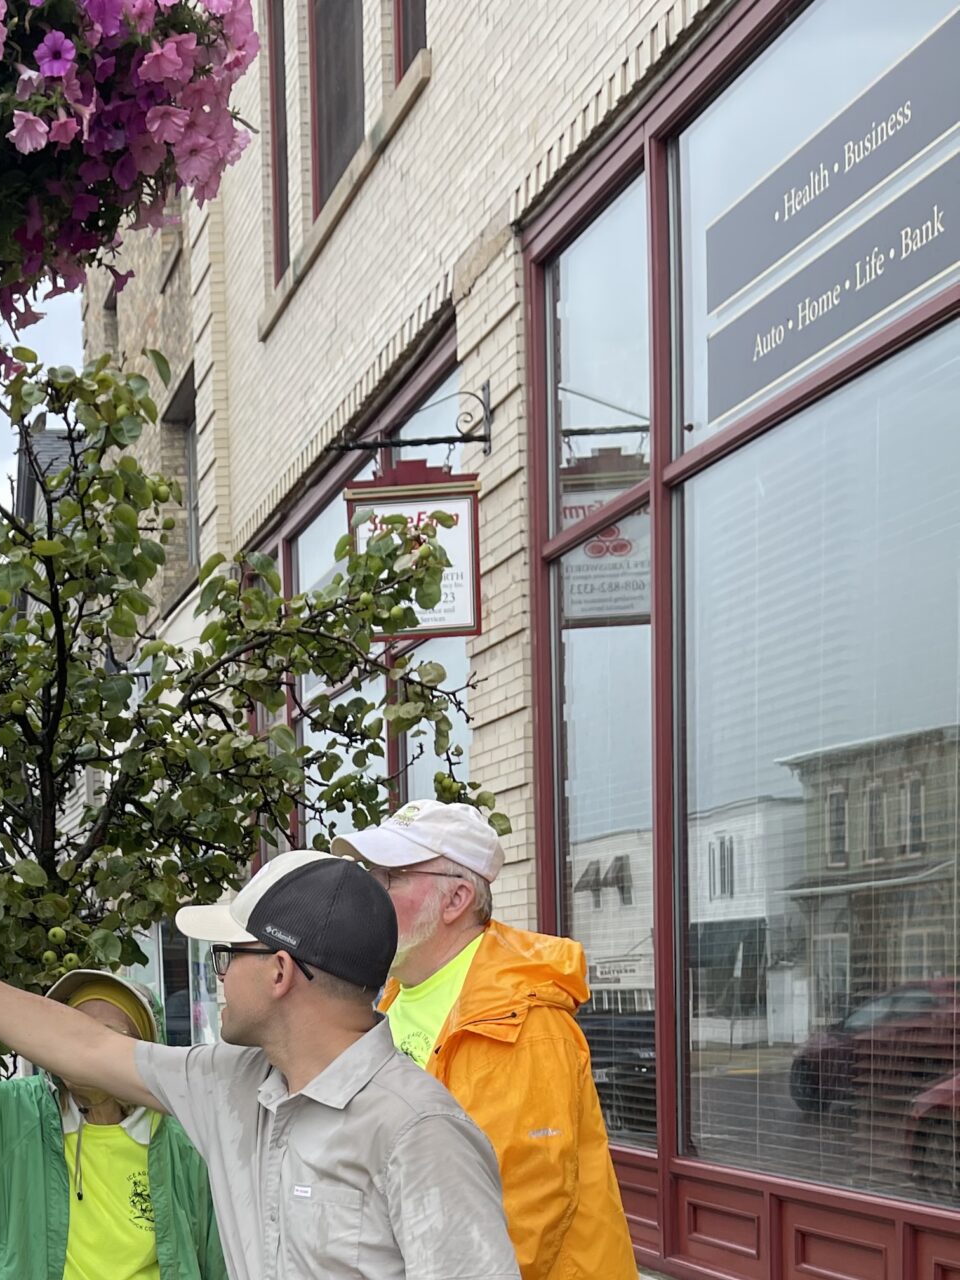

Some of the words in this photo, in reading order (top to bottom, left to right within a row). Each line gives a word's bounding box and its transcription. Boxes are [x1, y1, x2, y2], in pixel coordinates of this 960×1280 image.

[783, 163, 829, 221] Health
[844, 100, 912, 173] Business
[753, 323, 784, 362] Auto
[797, 284, 841, 331] Home
[855, 247, 885, 291] Life
[900, 204, 945, 260] Bank
[271, 928, 297, 945] Columbia
